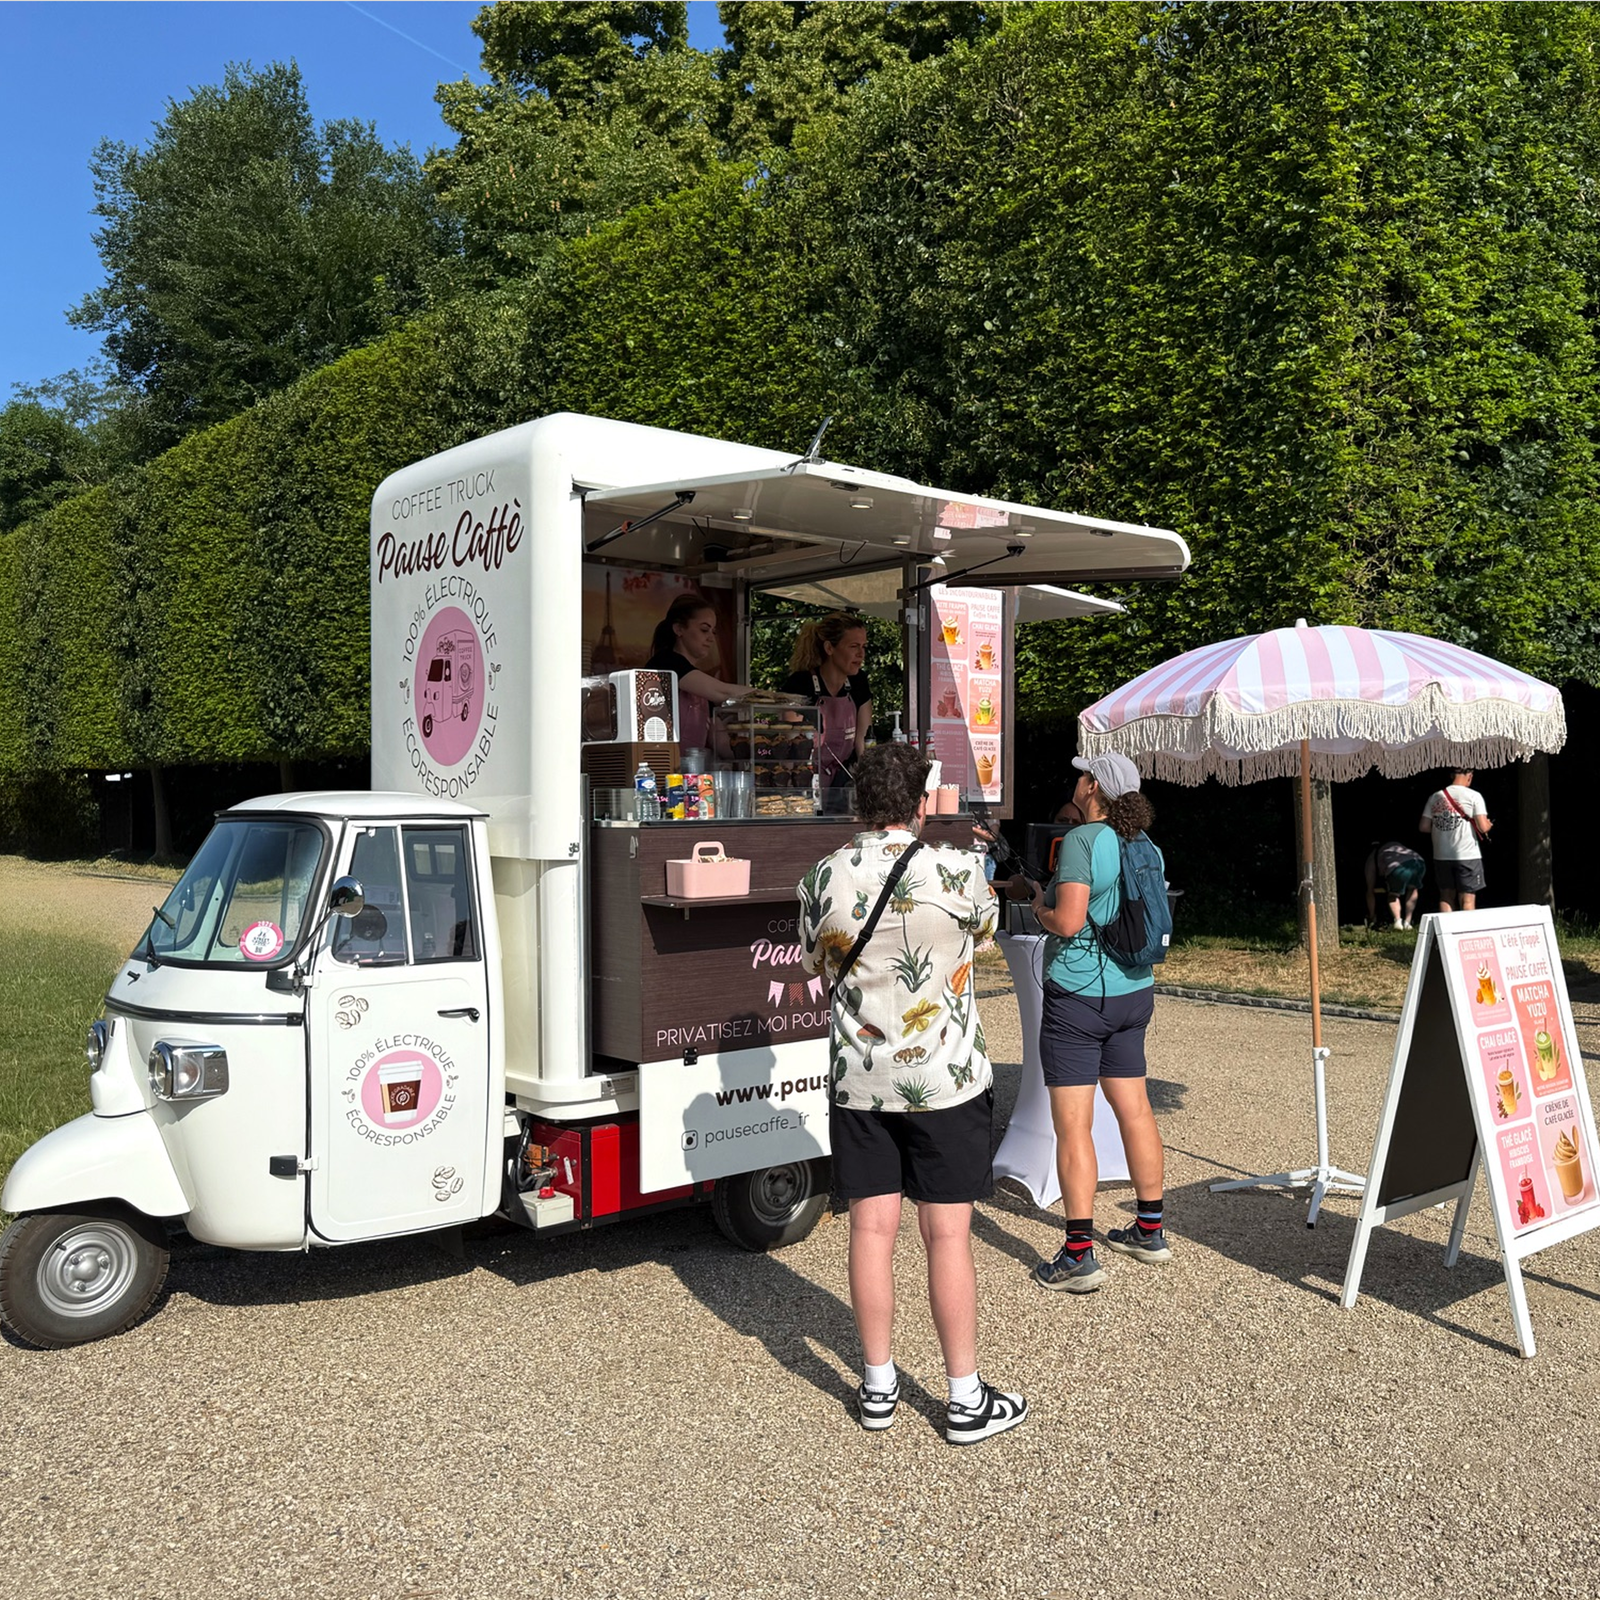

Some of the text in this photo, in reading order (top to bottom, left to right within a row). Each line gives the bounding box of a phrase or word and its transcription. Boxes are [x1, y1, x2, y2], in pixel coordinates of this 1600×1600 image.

[392, 469, 496, 521] COFFEE TRUCK
[377, 498, 525, 584] Pause Caffè
[402, 575, 497, 663] 100% ÉLECTRIQUE
[402, 702, 499, 799] ÉCORESPONSABLE
[1500, 934, 1518, 948] L'été
[1519, 949, 1527, 963] by
[1506, 964, 1528, 980] PAUSE
[1516, 984, 1550, 1003] MATCHA
[1526, 1002, 1547, 1018] YUZU
[656, 1010, 833, 1047] PRIVATISEZ MOI POUR
[1480, 1034, 1496, 1049] CHAI
[346, 1034, 455, 1082] 100% ÉLECTRIQUE
[1562, 1099, 1569, 1108] DE
[346, 1093, 456, 1147] ÉCORESPONSABLE
[1544, 1108, 1574, 1126] CAFÉ GLACÉE
[705, 1112, 810, 1148] pausecaffe_fr
[1501, 1126, 1533, 1149] THÉ GLACÉ
